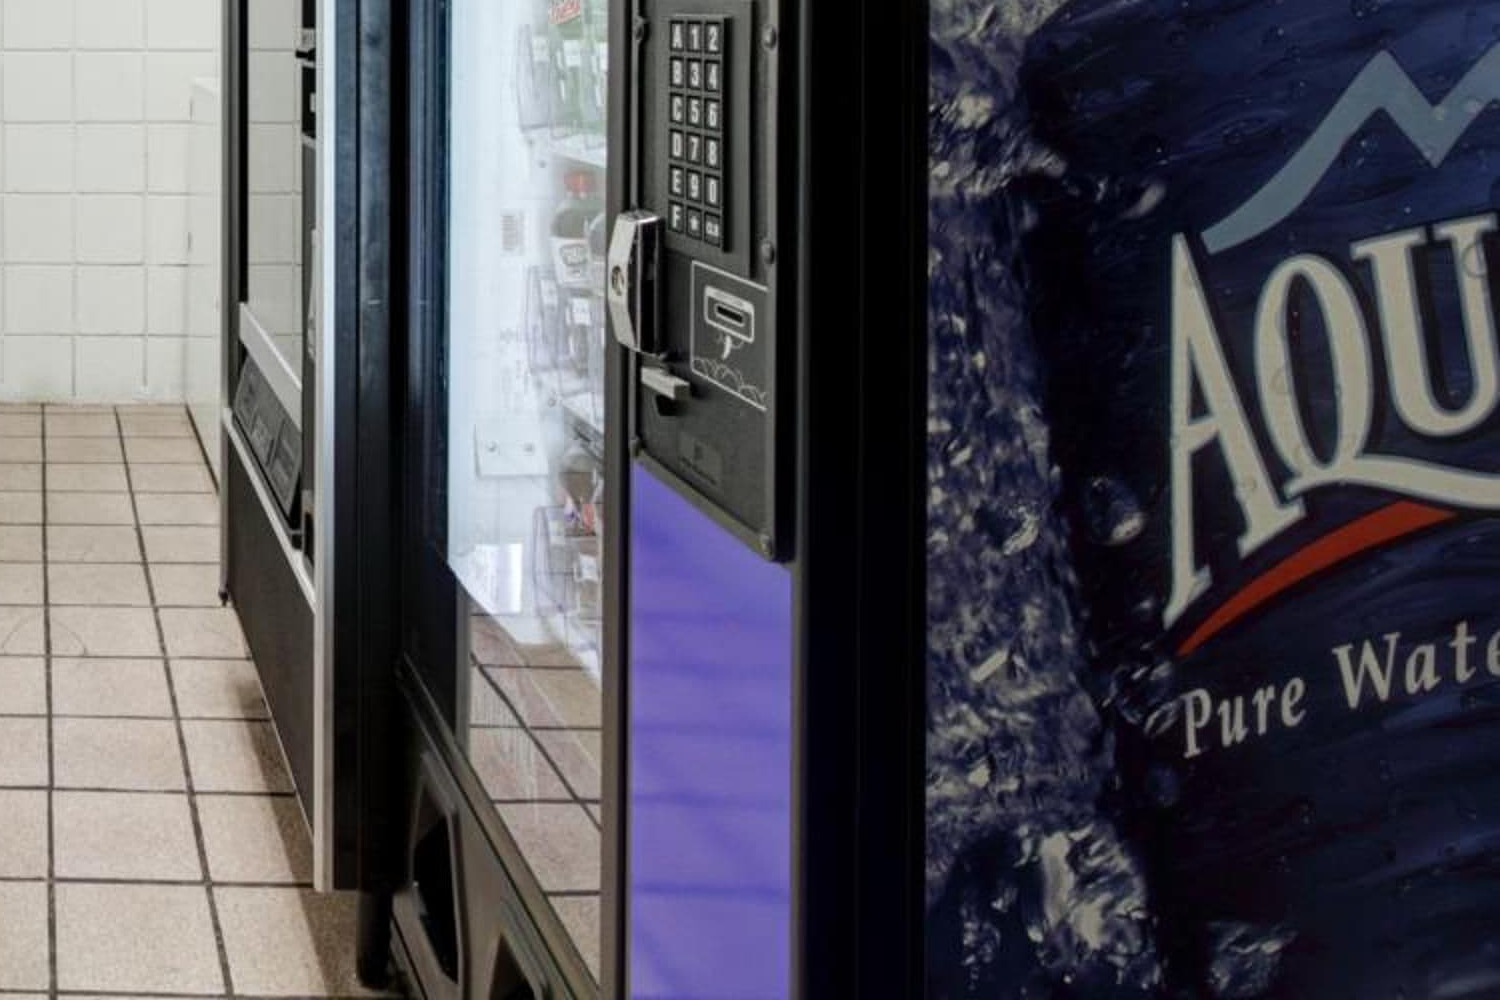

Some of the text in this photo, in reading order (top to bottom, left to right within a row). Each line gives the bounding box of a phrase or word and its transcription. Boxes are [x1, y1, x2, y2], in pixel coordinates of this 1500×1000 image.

[672, 24, 718, 51] A 1 2
[672, 60, 717, 89] B 3 4
[672, 96, 717, 127] C 5 6
[672, 132, 717, 166] D 7 8
[672, 169, 717, 204] E 9 0
[672, 204, 681, 229] F
[1181, 676, 1307, 759] Pure
